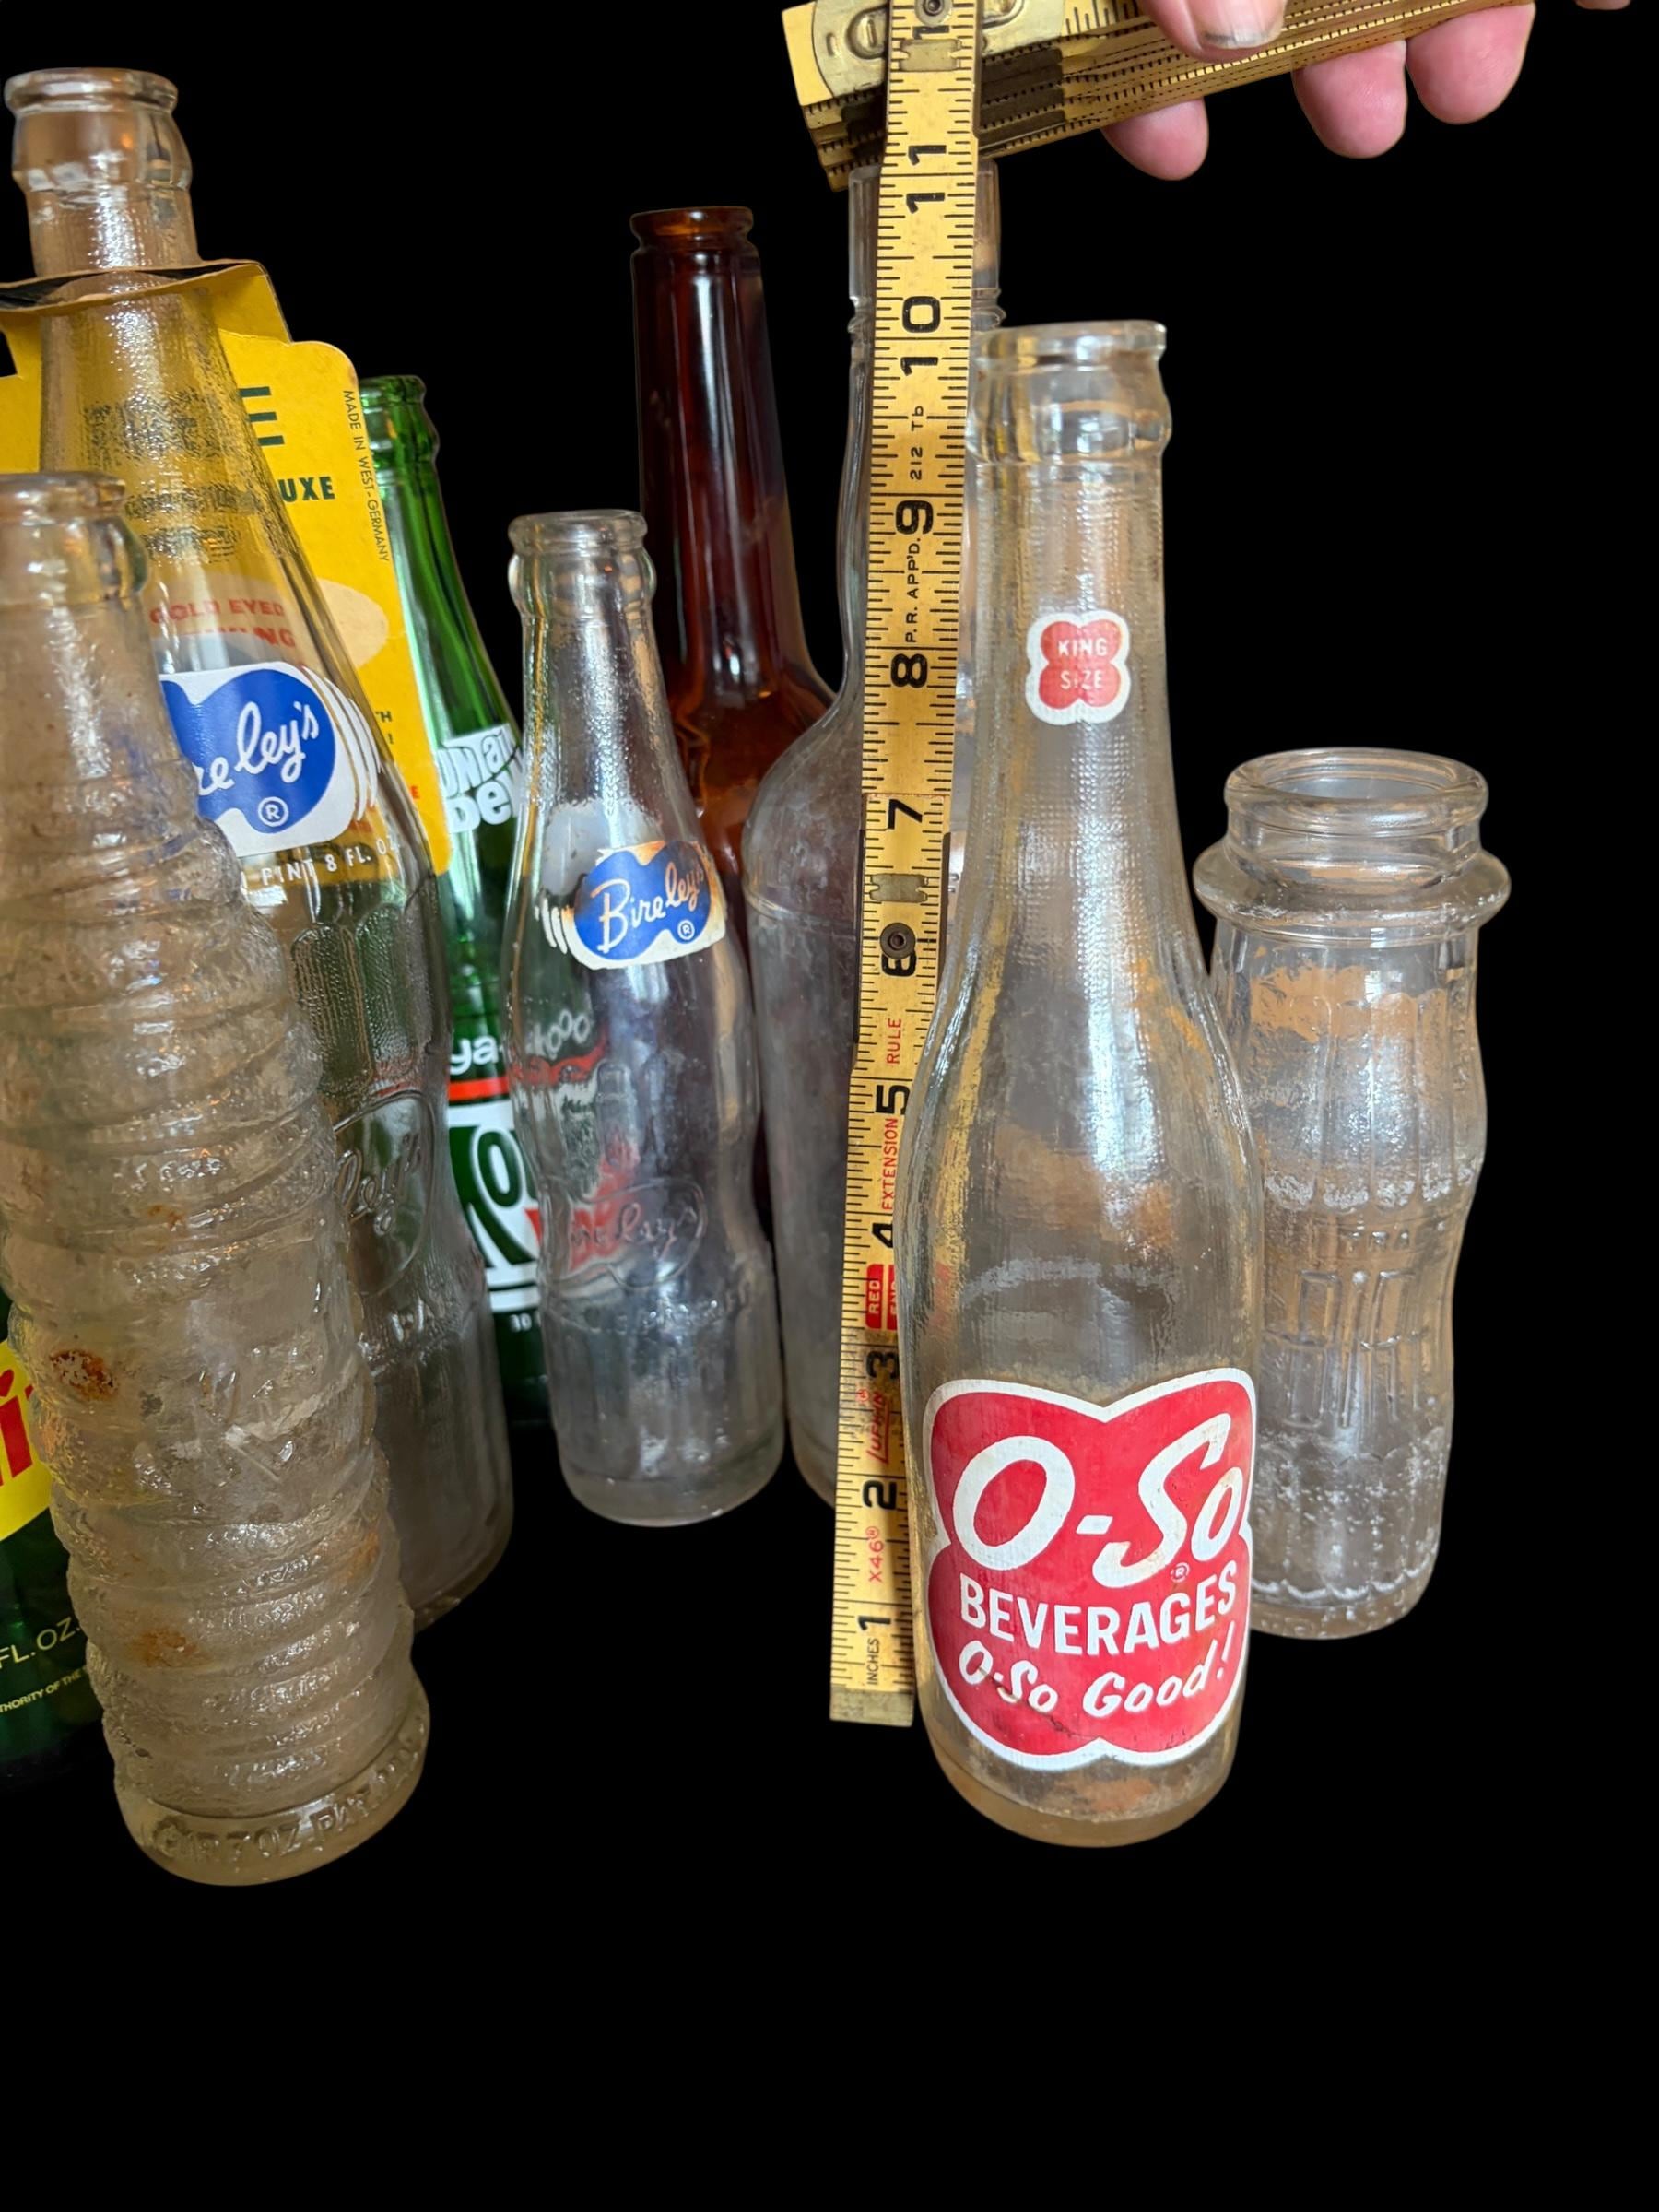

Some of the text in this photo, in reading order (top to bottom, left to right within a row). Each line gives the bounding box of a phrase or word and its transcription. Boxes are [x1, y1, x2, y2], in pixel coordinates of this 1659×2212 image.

[343, 390, 362, 431] MADE
[353, 435, 366, 452] IN
[276, 476, 335, 503] UXE
[895, 500, 934, 535] 9
[1057, 637, 1108, 657] KING
[890, 653, 928, 688] 8
[191, 700, 321, 796] reley's
[888, 798, 923, 830] 7
[261, 857, 315, 886] PINT
[324, 853, 338, 872] 8
[345, 845, 371, 867] FL.
[876, 1084, 911, 1115] 5
[881, 1018, 902, 1210] EXTENSION RULE
[868, 1279, 881, 1315] RED
[865, 1350, 900, 1380] 3
[862, 1479, 898, 1511] 2
[857, 1615, 892, 1632] 1
[959, 1559, 1238, 1656] BEVERAGES
[866, 1637, 881, 1686] INCHES
[1082, 1622, 1235, 1718] Good!
